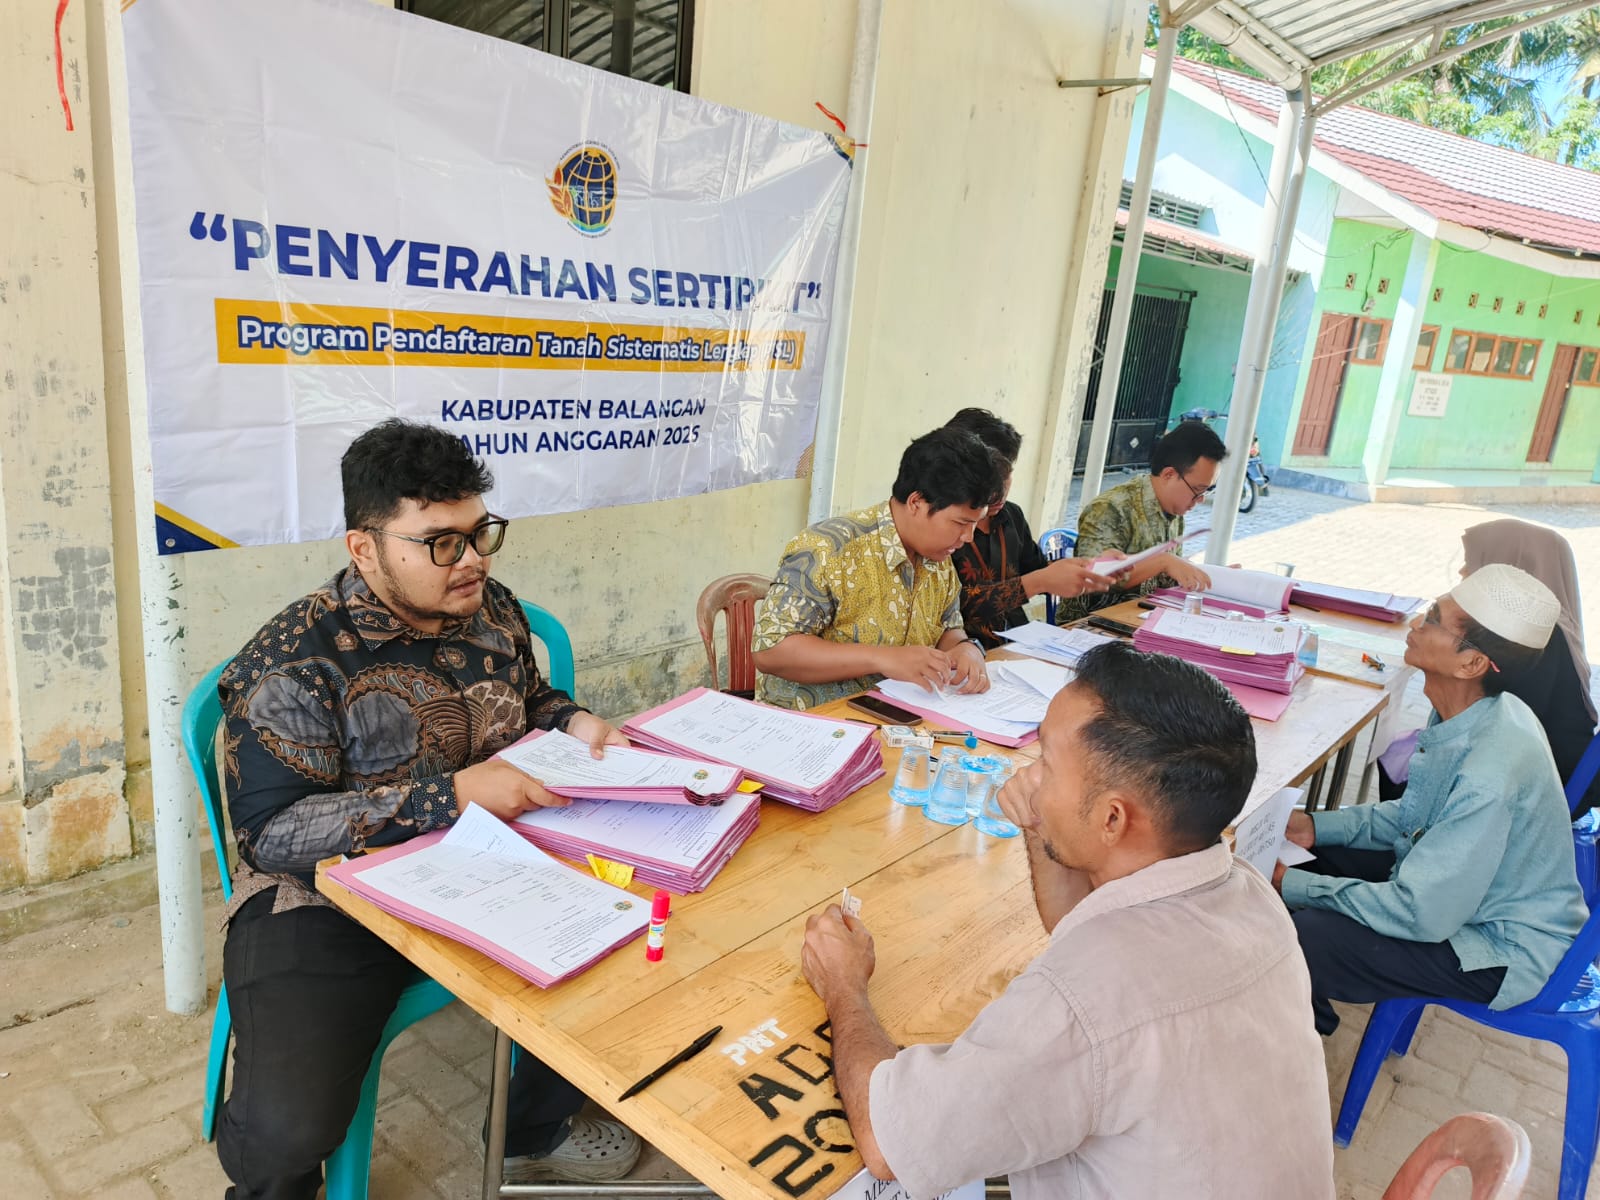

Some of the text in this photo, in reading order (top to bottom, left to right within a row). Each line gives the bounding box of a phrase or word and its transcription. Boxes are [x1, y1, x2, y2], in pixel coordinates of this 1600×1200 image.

[237, 315, 368, 356] Program
[372, 322, 531, 356] Pendaftaran
[536, 330, 602, 360] Tanah
[606, 332, 700, 362] Sistematis
[442, 398, 706, 422] KABUPATEN BALANGAN
[460, 425, 701, 456] AHUN ANGGARAN 2025
